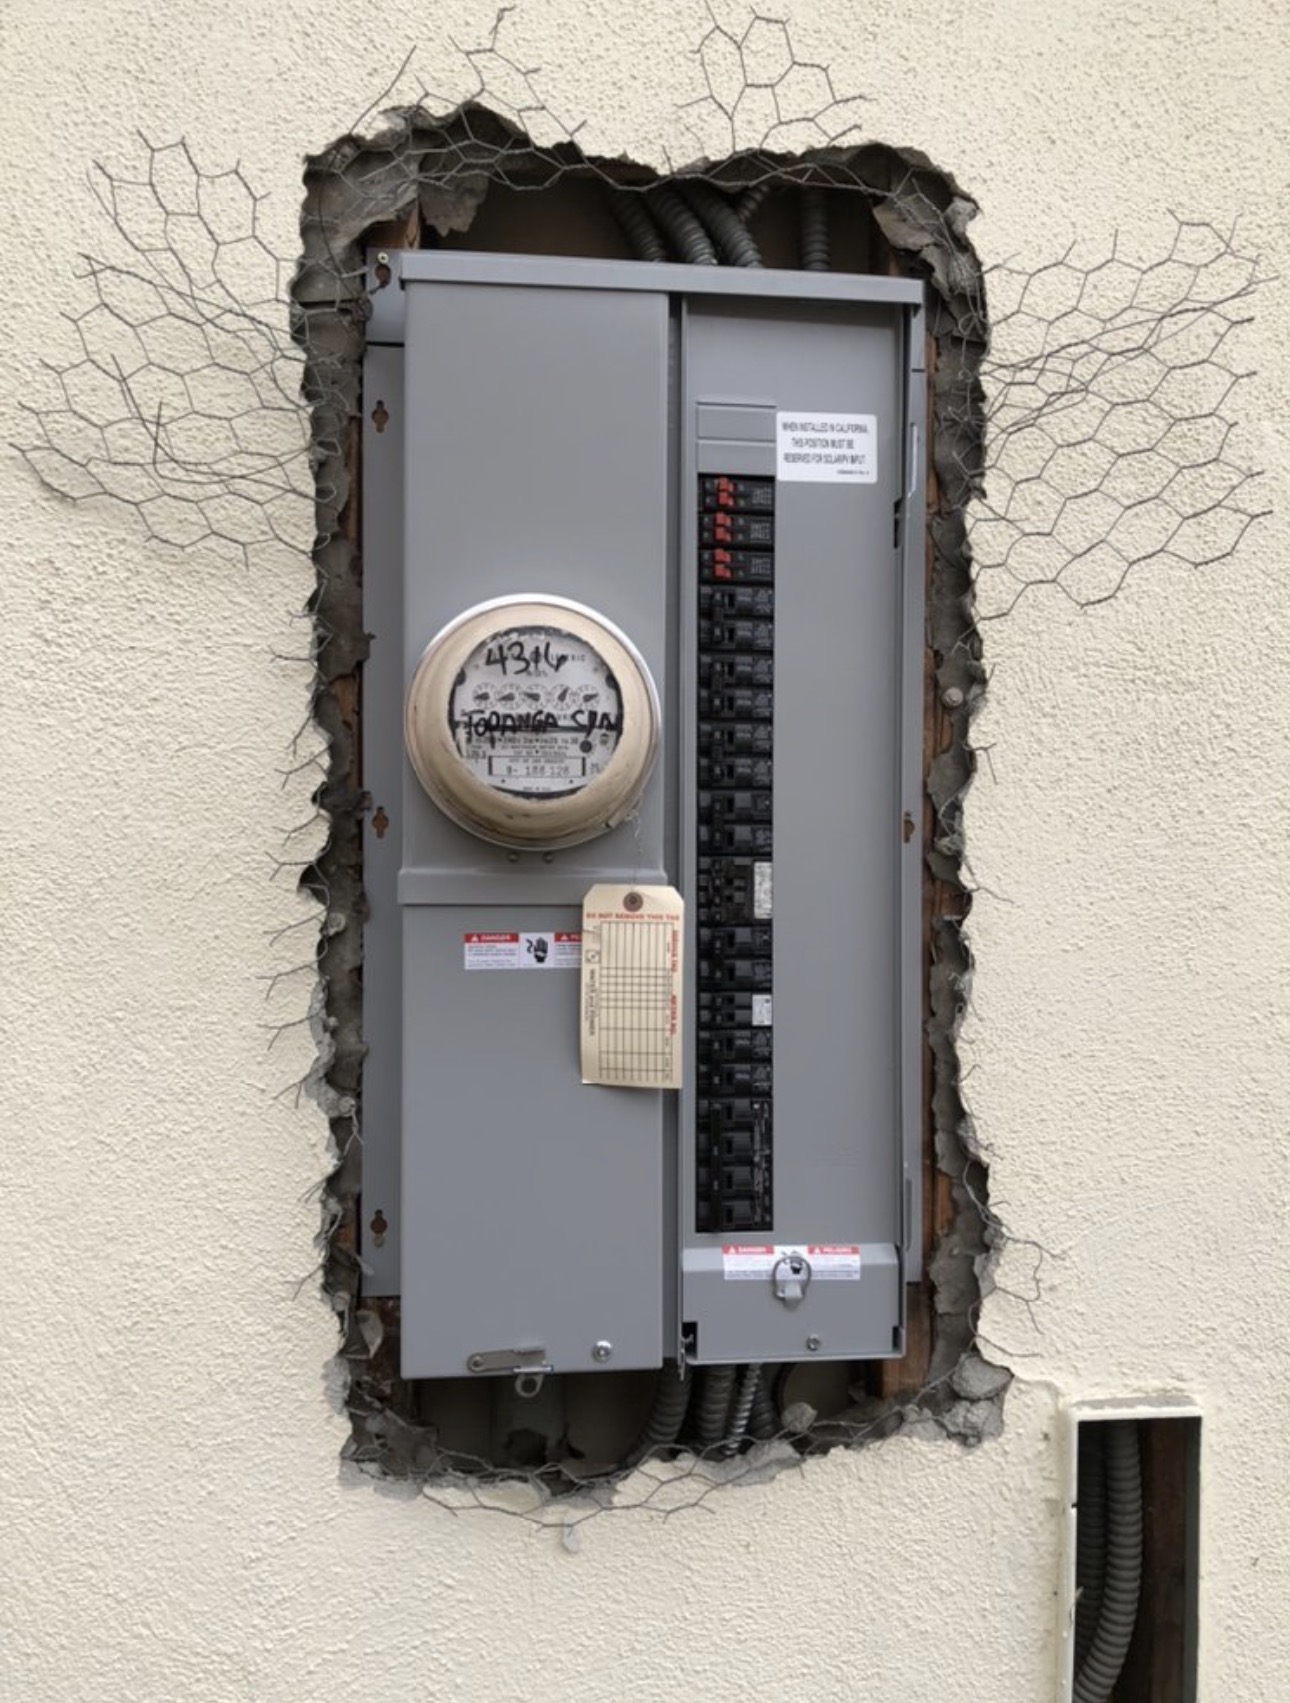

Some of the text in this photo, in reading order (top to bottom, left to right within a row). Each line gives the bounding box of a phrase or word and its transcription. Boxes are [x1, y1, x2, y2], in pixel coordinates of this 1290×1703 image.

[800, 422, 828, 433] INSTALLED
[804, 438, 830, 448] POSITION
[485, 641, 568, 676] 4316
[464, 709, 559, 749] TOPANGA
